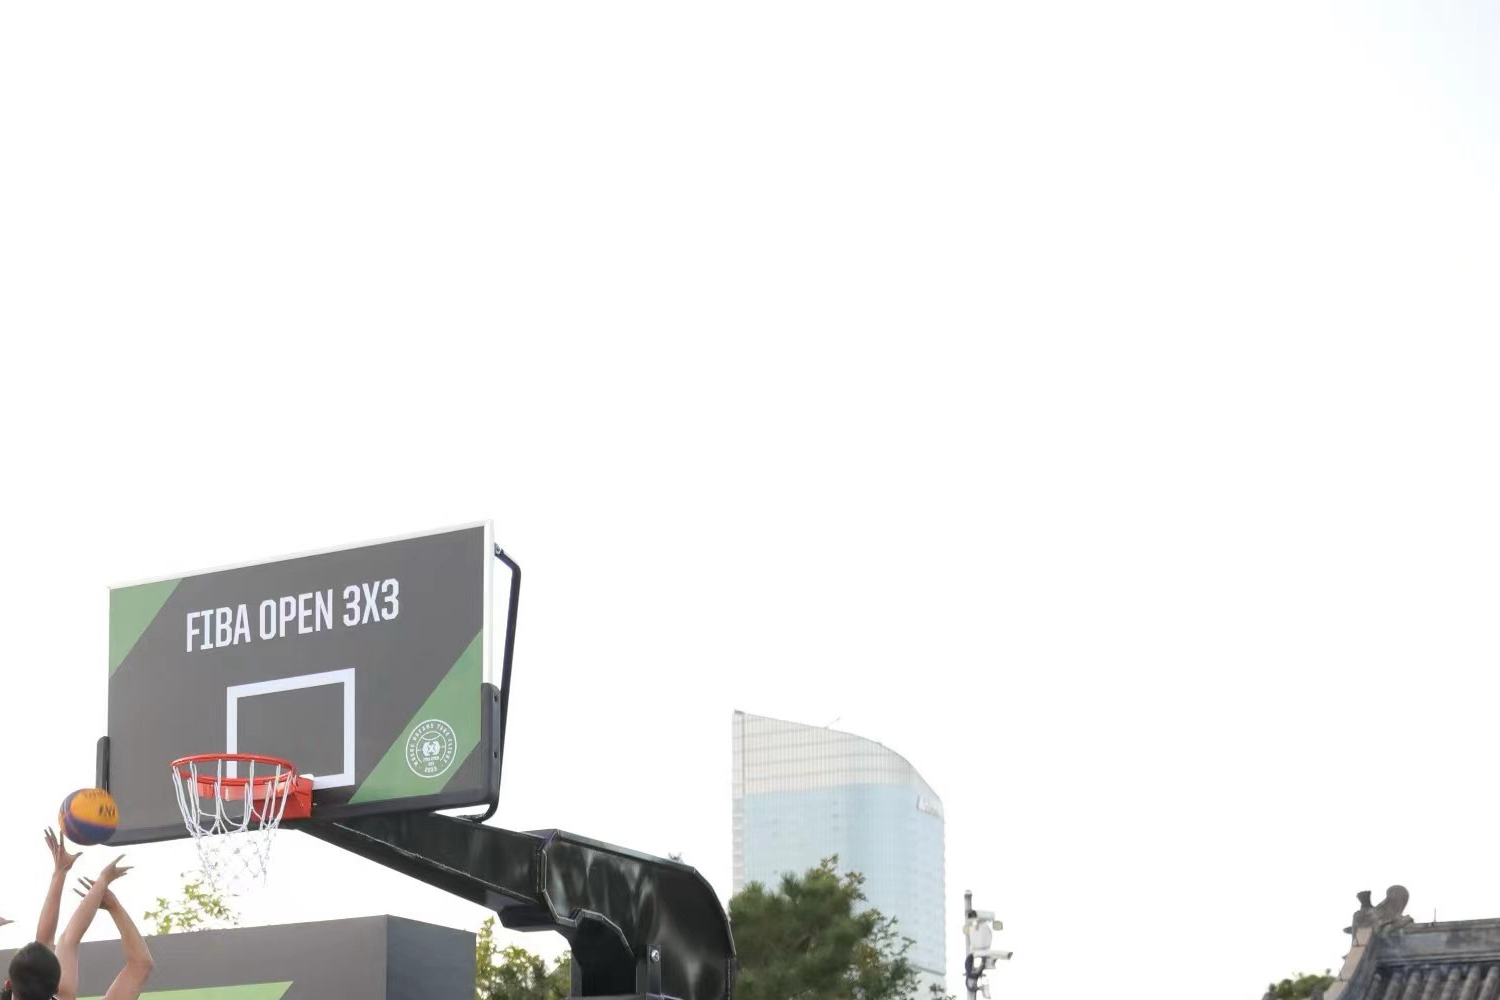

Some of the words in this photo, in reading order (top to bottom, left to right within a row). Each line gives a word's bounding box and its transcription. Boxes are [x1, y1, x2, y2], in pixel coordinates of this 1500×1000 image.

[186, 603, 252, 653] FIBA
[259, 588, 334, 641] OPEN
[342, 578, 400, 627] 3X3
